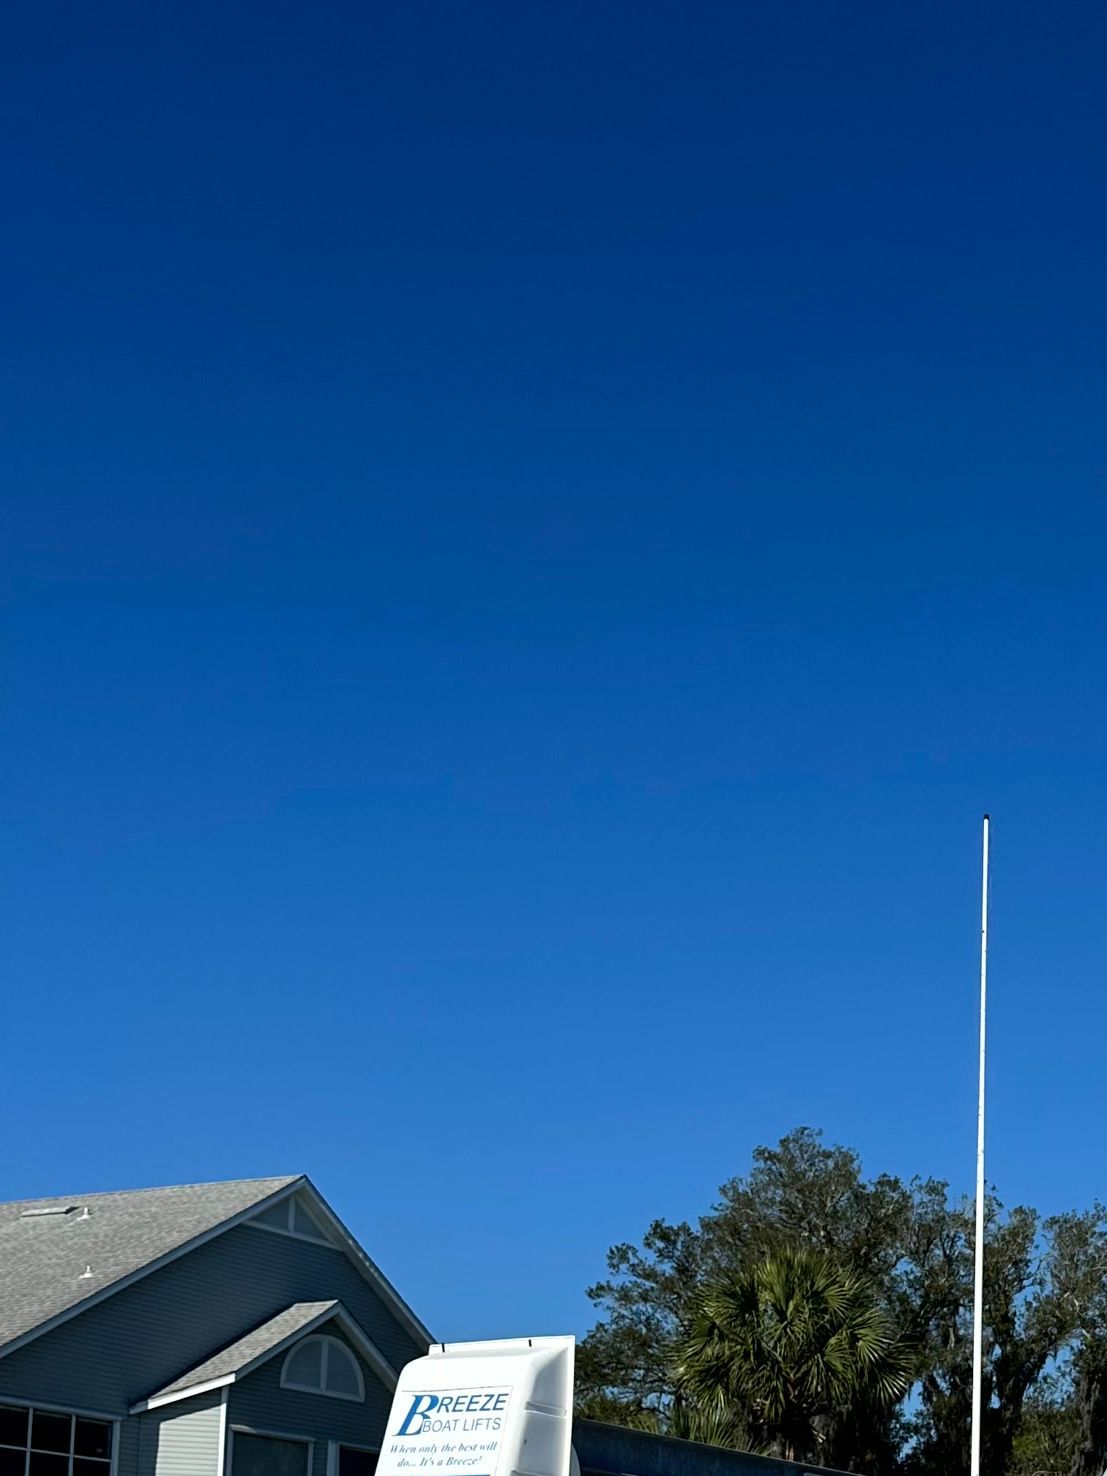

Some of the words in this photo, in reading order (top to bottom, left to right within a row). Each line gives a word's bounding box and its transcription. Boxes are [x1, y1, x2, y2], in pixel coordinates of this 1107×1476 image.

[392, 1393, 509, 1436] BREEZE
[422, 1419, 459, 1432] BOAT
[463, 1417, 501, 1431] LIFTS
[390, 1444, 416, 1453] When
[419, 1443, 438, 1456] only
[441, 1442, 456, 1452] the
[458, 1441, 478, 1451] best
[480, 1441, 498, 1451] will
[420, 1457, 435, 1466] It's
[446, 1455, 483, 1466] Breeze!
